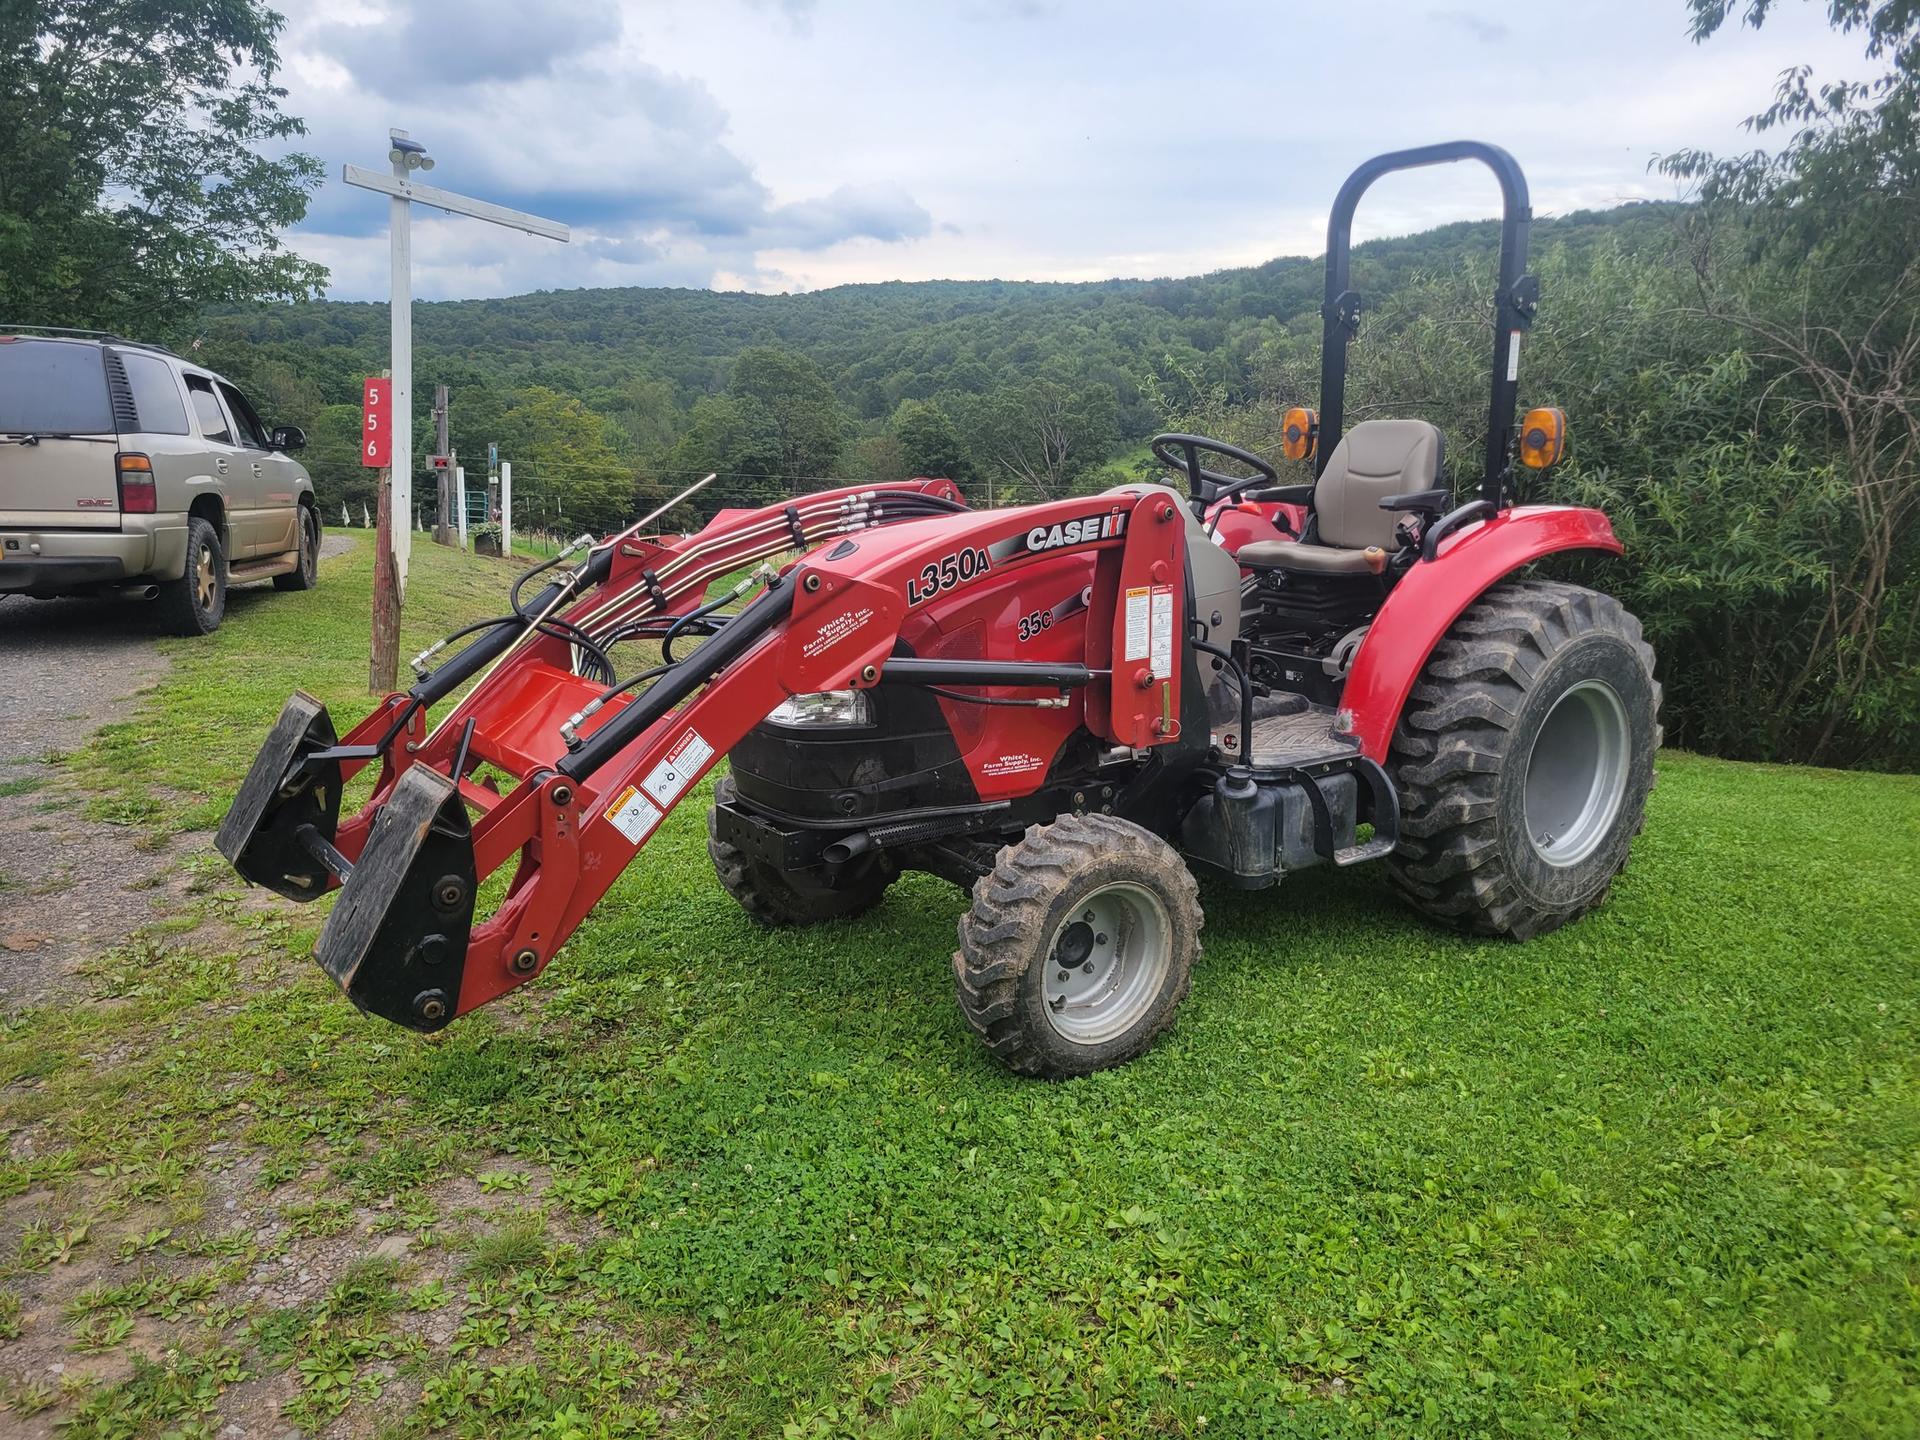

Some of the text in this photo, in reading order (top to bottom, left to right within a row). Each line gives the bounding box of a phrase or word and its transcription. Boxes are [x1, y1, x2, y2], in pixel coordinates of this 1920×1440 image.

[77, 496, 113, 507] GMC
[1026, 517, 1101, 552] CASE
[907, 547, 990, 607] L350A
[802, 636, 826, 652] Farm
[854, 607, 871, 618] Inc.
[817, 611, 852, 636] White's
[1017, 609, 1054, 643] 35C
[673, 733, 694, 757] DANGER
[1000, 754, 1029, 763] White's
[614, 791, 632, 813] WARNING
